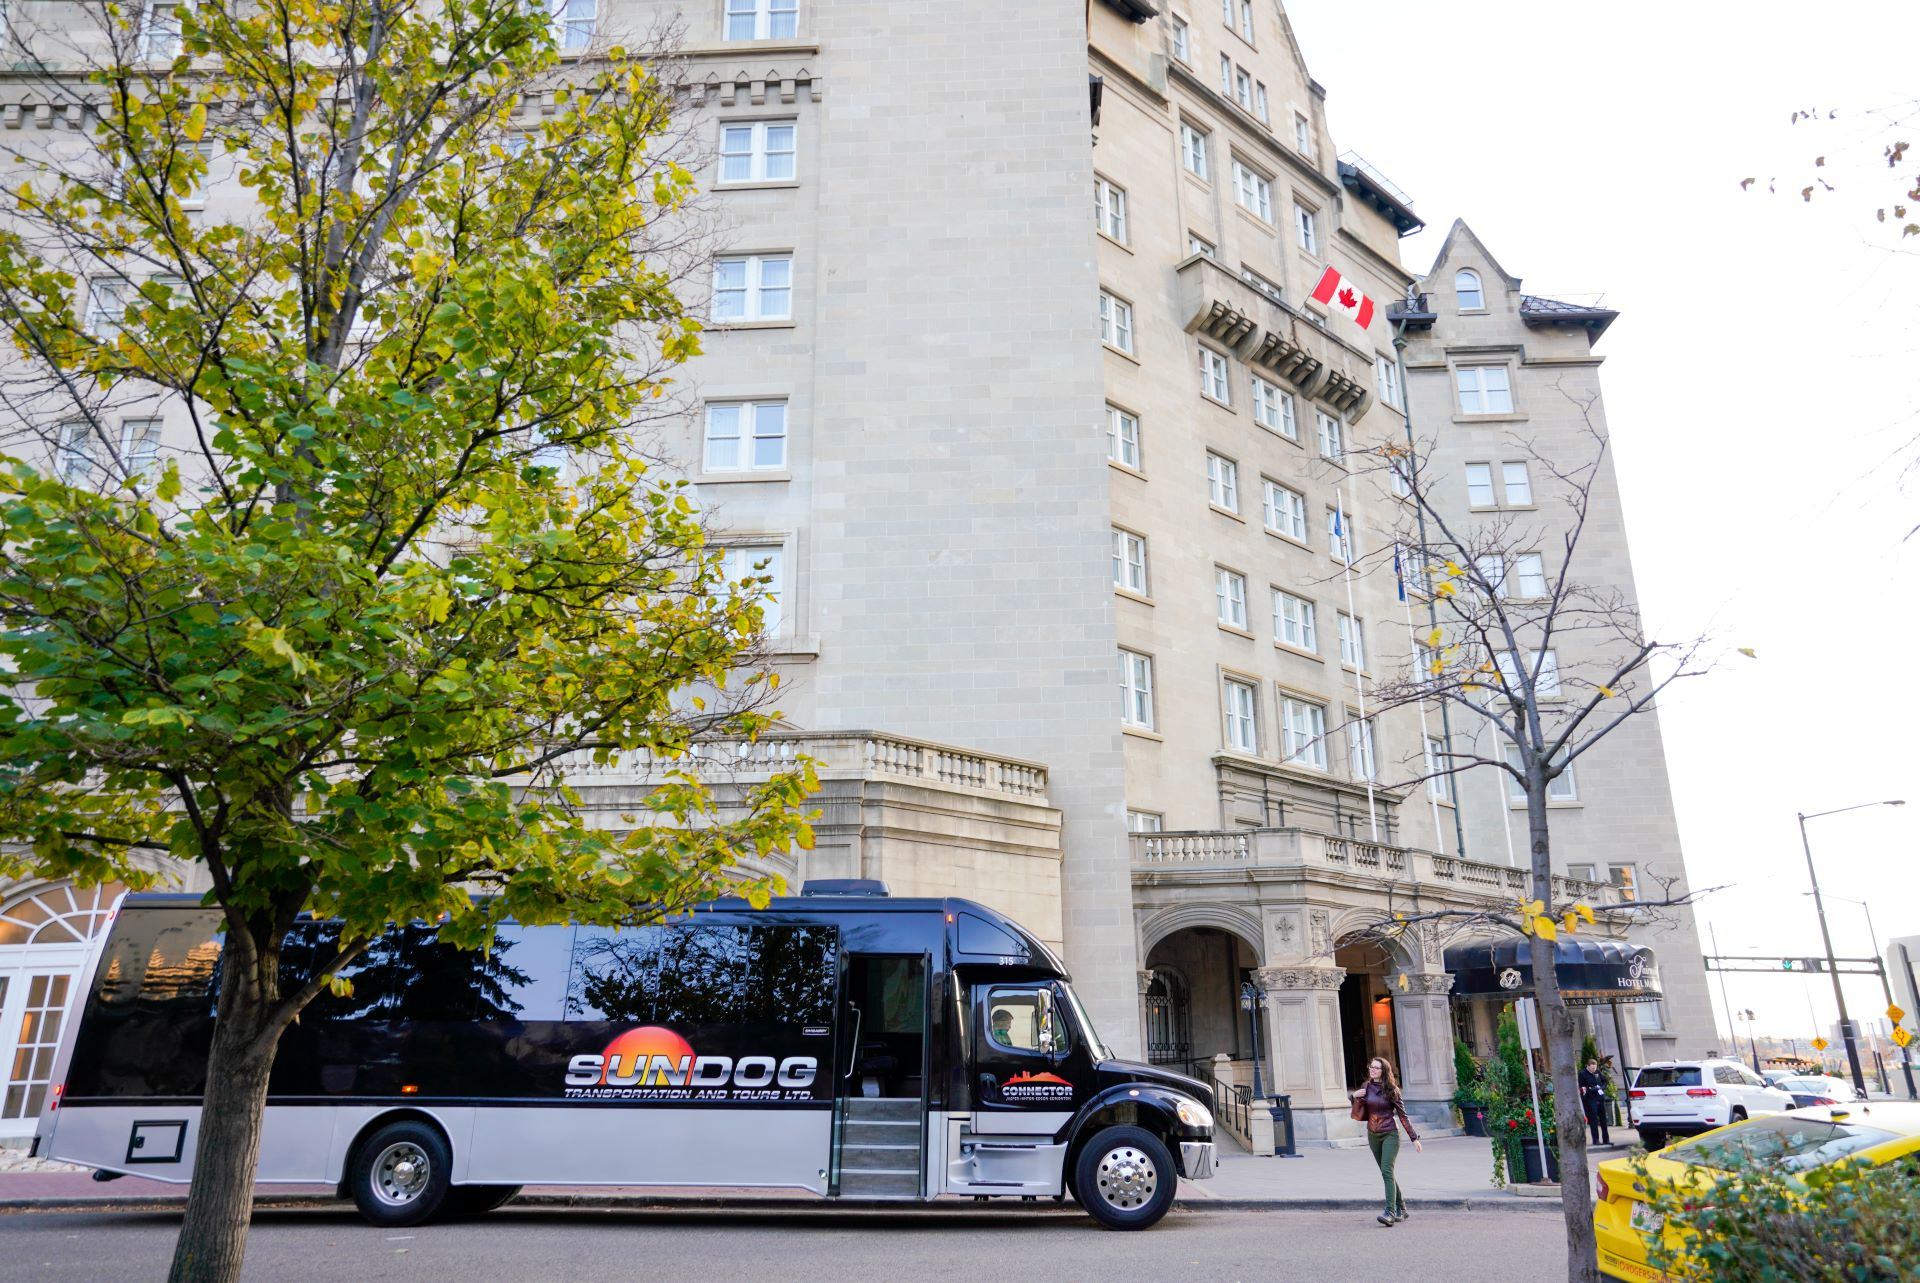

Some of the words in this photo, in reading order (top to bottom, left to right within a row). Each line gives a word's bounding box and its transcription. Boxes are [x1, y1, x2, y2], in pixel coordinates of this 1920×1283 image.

[999, 957, 1014, 966] 315
[564, 1054, 818, 1088] SUNDOG
[564, 1088, 692, 1099] TRANSPORTATION
[695, 1089, 727, 1100] AND
[732, 1090, 780, 1100] TOURS
[784, 1090, 814, 1101] LTD.
[1002, 1086, 1073, 1096] CONNECTOR
